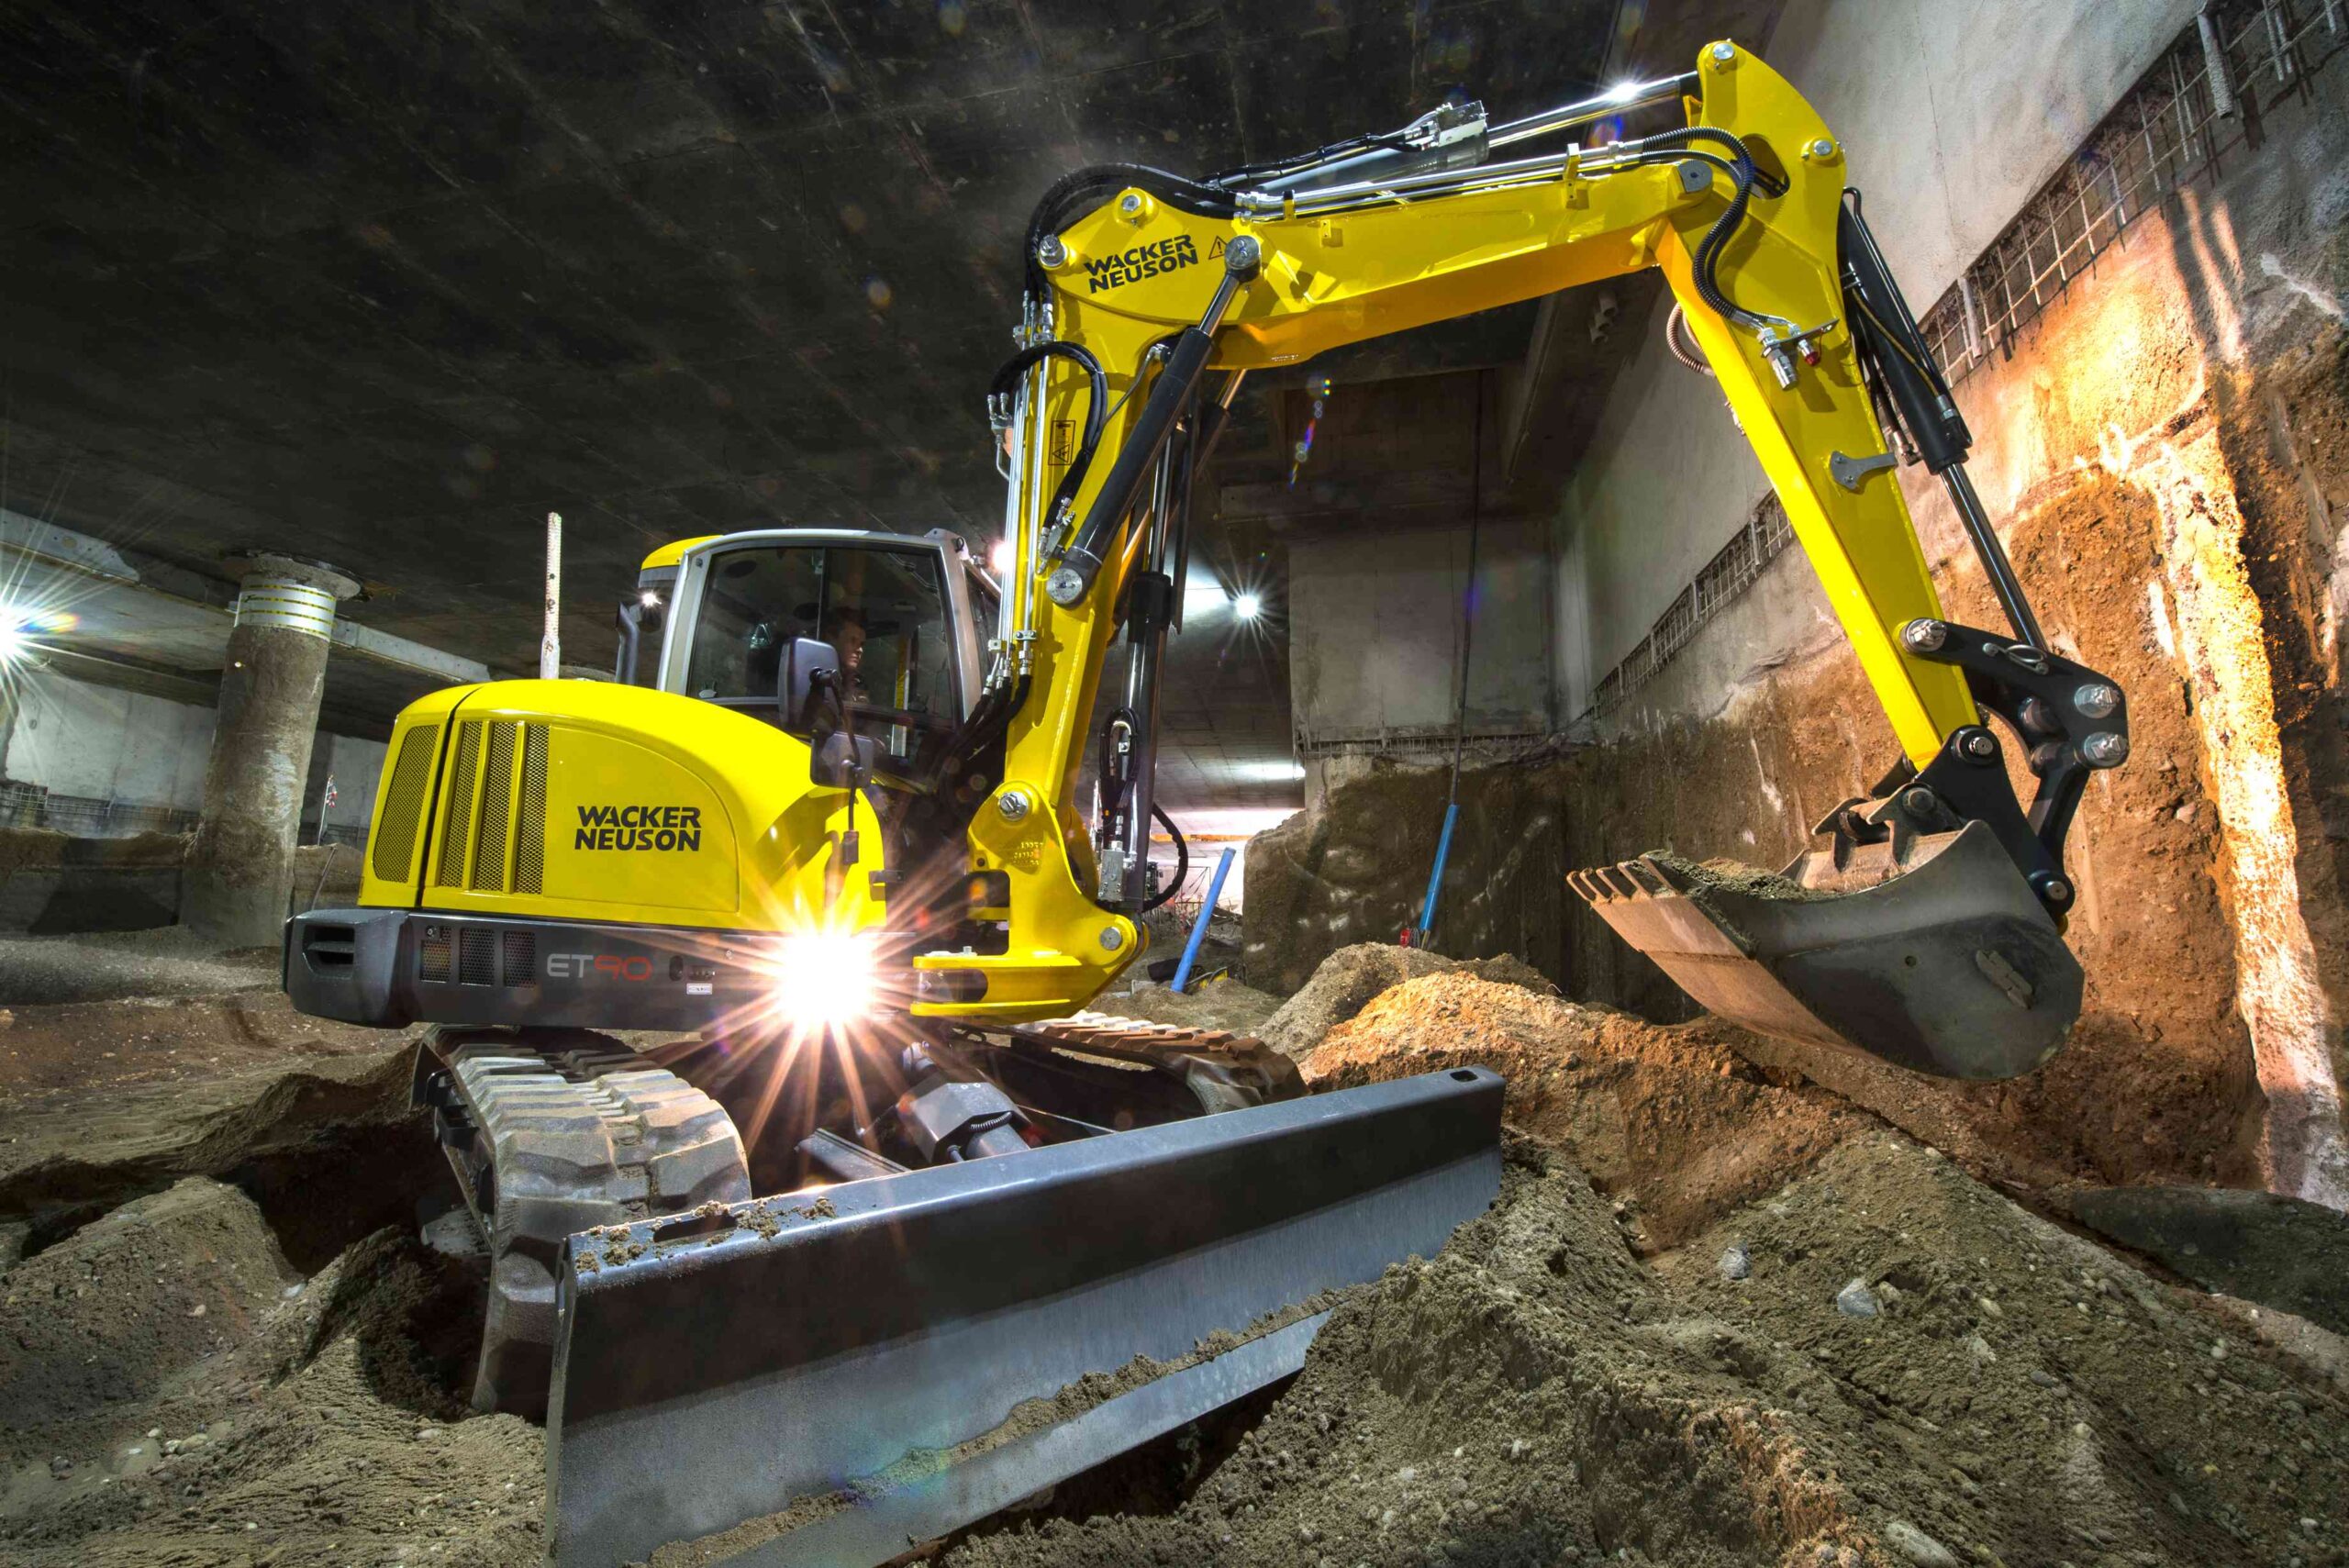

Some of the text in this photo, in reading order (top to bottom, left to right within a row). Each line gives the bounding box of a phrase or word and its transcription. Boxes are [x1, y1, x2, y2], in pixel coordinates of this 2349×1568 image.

[1084, 234, 1196, 276] WACKER
[1088, 250, 1198, 294] NEUSON
[577, 806, 701, 828] WACKER
[574, 828, 701, 851] NEUSON
[547, 953, 652, 981] ET90
